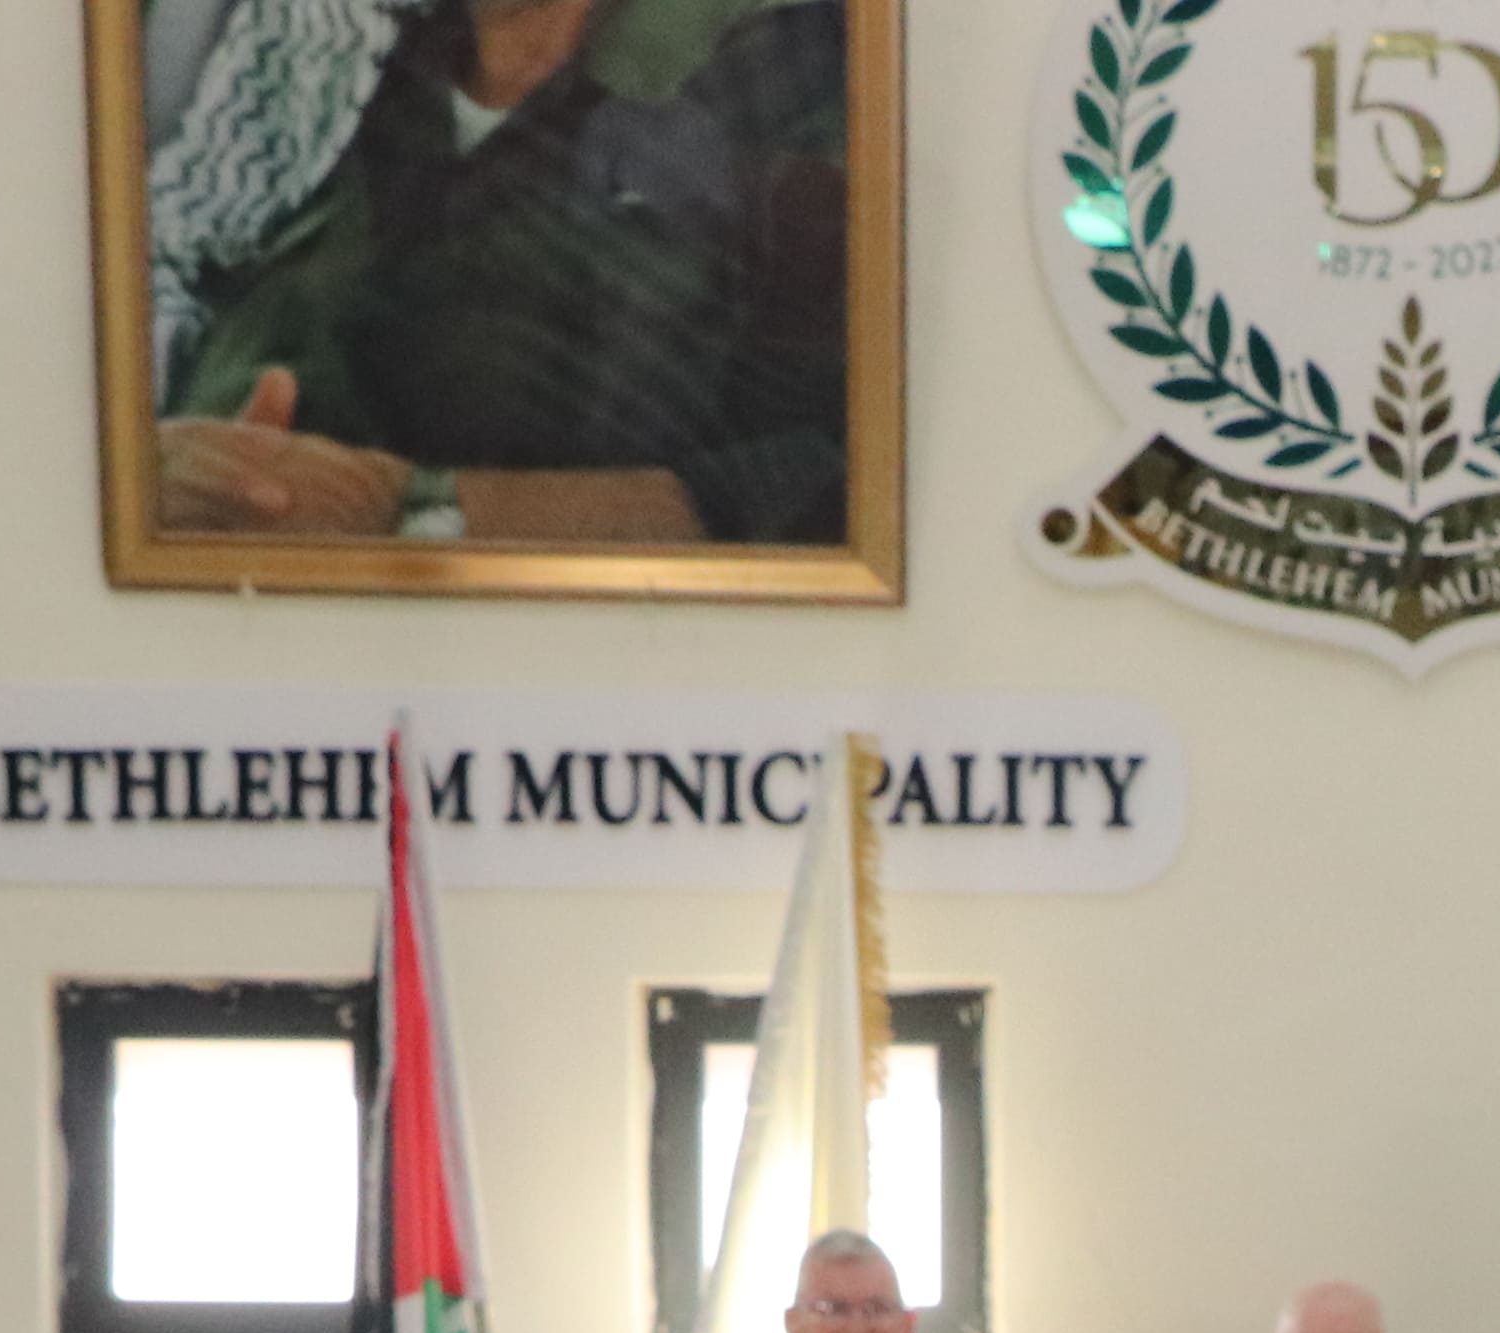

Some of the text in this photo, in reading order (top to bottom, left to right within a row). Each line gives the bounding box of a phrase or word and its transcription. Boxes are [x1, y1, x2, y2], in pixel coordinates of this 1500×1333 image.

[1190, 477, 1291, 532] لحم
[1135, 497, 1397, 621] BETHLEHEM
[503, 749, 1146, 830] MUNICALITY
